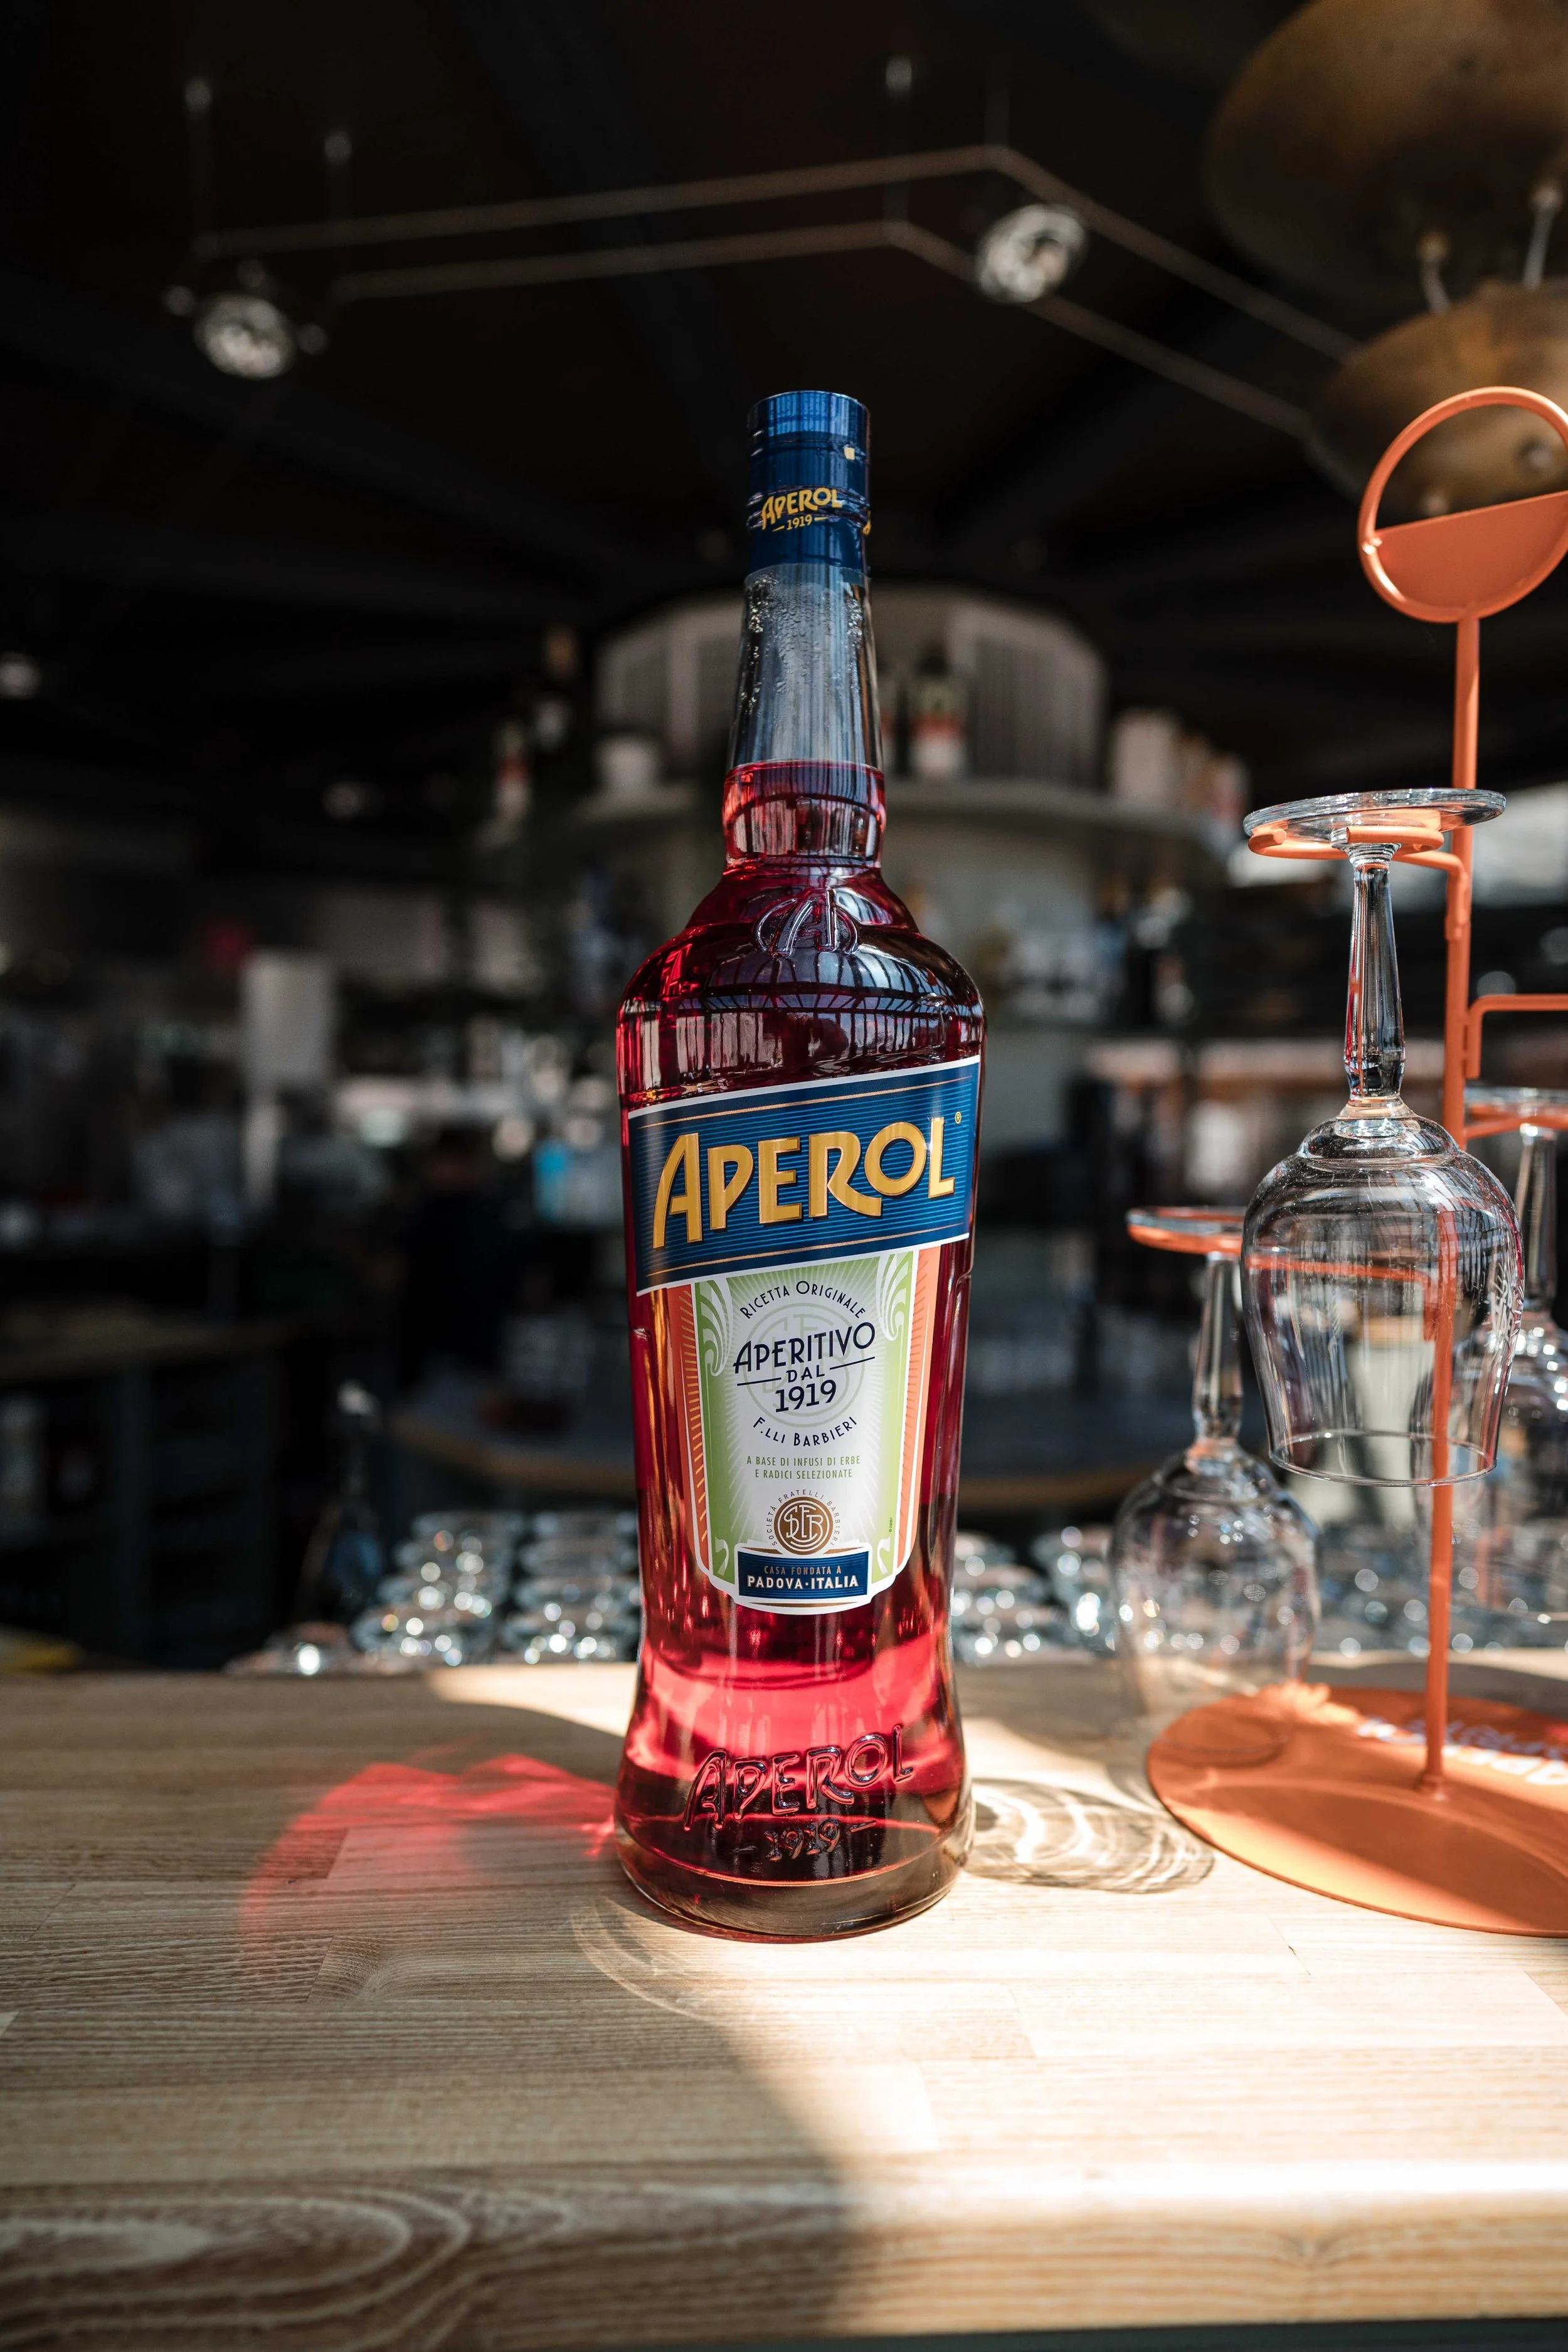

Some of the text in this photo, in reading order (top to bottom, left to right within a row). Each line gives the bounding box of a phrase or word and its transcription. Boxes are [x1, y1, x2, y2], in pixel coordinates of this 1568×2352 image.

[761, 487, 842, 531] APEROL
[786, 514, 813, 531] 1919
[739, 1280, 866, 1319] RICETTA ORIGINALE
[733, 1322, 876, 1374] APERITIVO
[785, 1364, 825, 1383] DAL
[775, 1379, 837, 1412] 1919
[753, 1416, 857, 1447] F.LLI BARBIERI
[746, 1455, 861, 1466] A BASE DI INFUSI DI ERBE
[755, 1469, 852, 1480] E RADICI SELEZIONATE
[778, 1489, 824, 1503] FRATELLI
[826, 1500, 840, 1546] BARBIERI
[763, 1565, 842, 1576] CASA FONDATA A
[683, 1724, 914, 1832] APEROL
[763, 1818, 840, 1862] 1919
